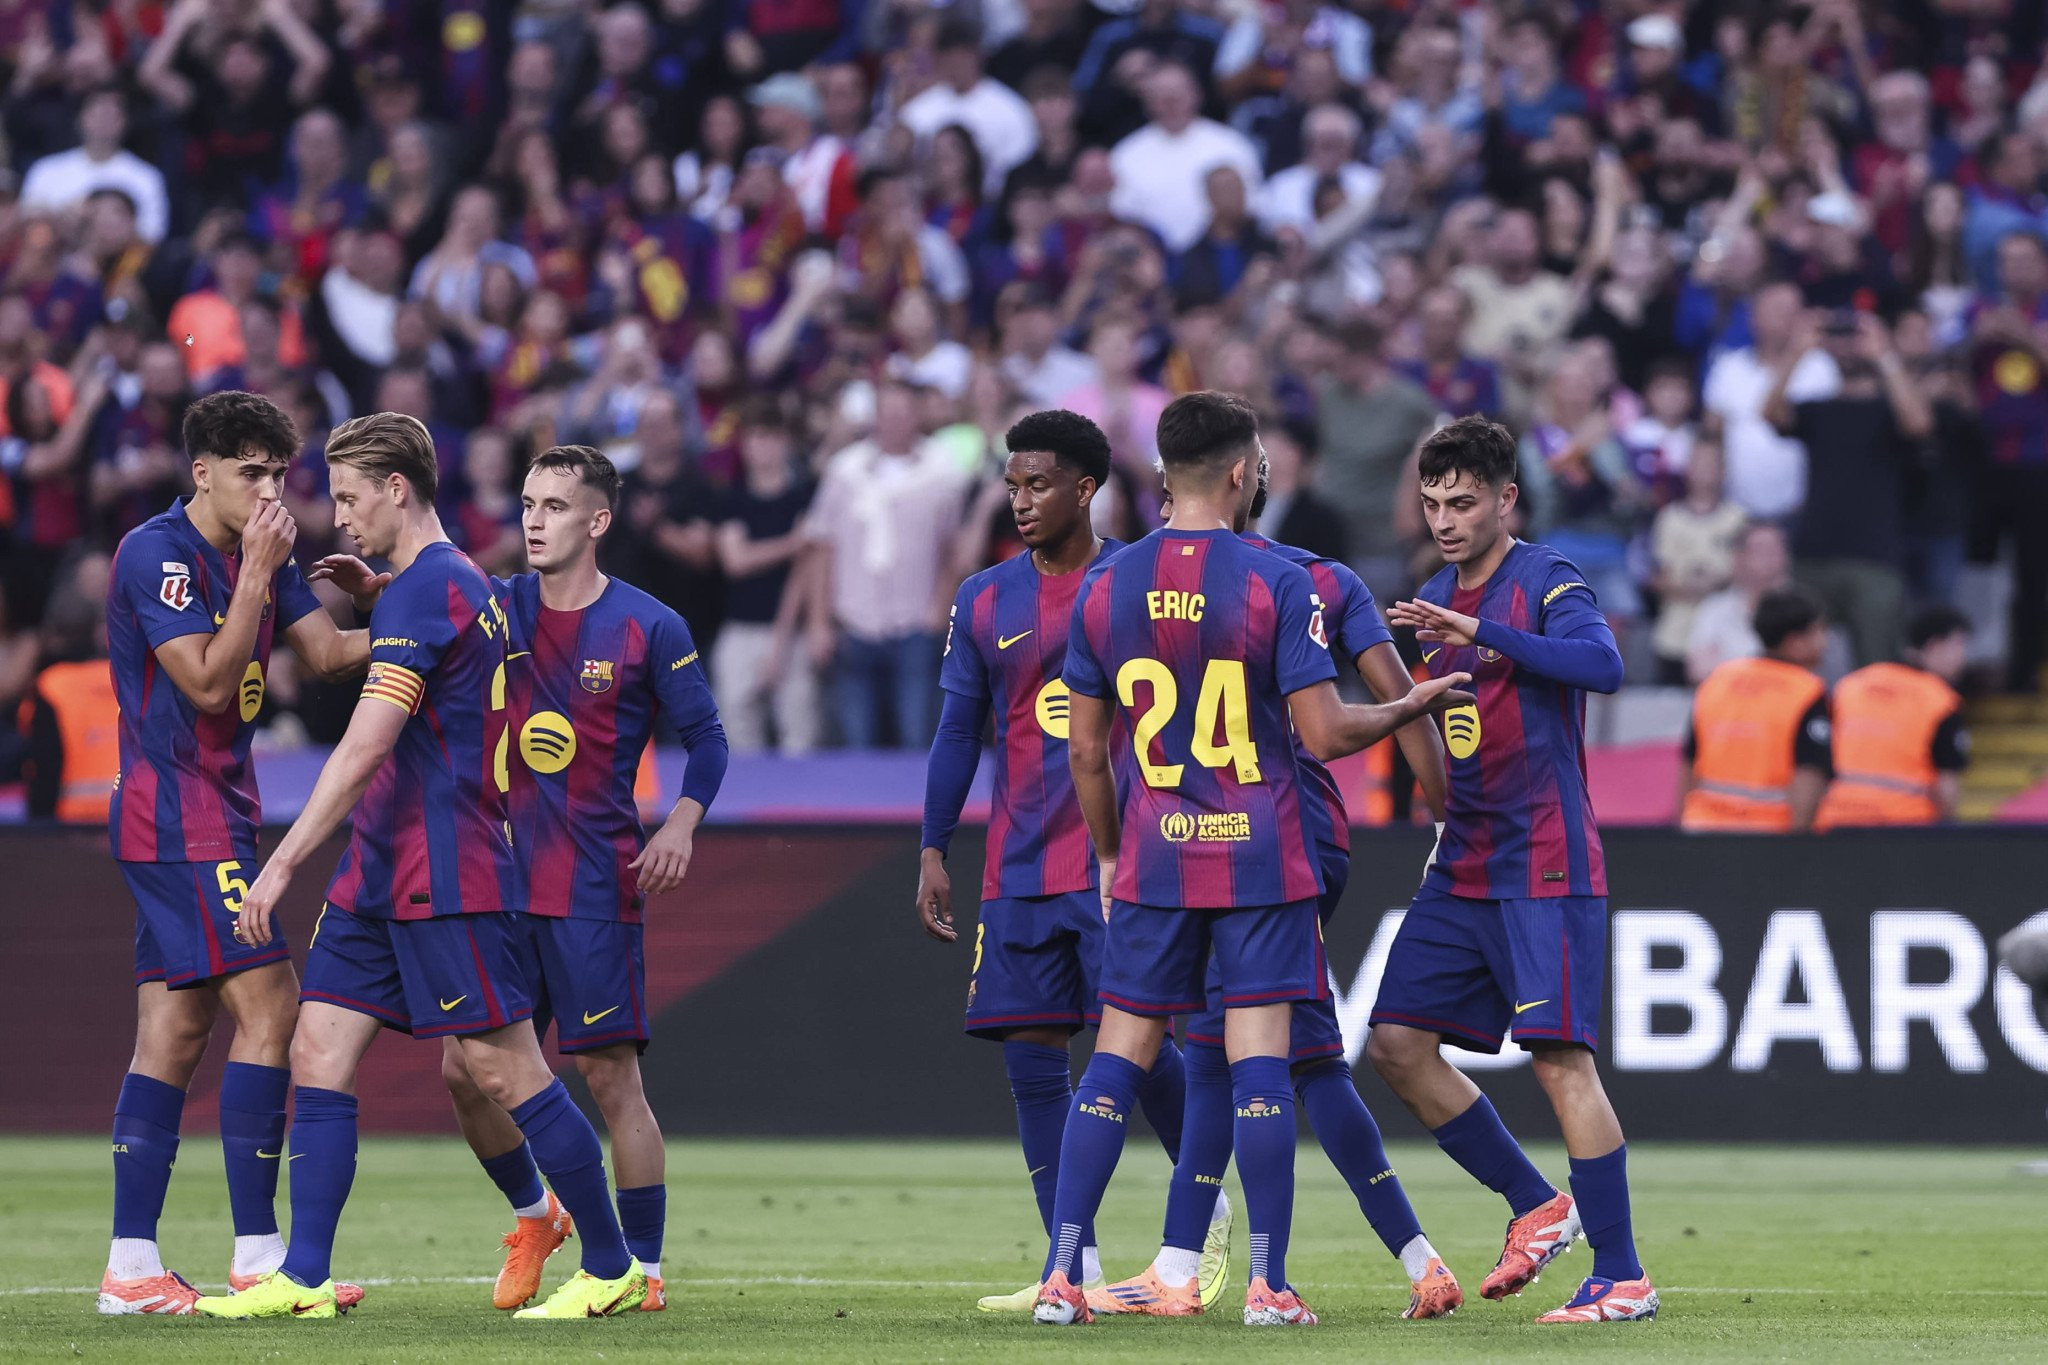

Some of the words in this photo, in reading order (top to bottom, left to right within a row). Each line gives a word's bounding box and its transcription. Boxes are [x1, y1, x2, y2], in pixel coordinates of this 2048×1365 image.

[1146, 590, 1206, 622] ERIC
[1116, 657, 1262, 787] 24
[1197, 812, 1249, 826] UNHCR
[1197, 824, 1251, 837] ACNUR
[215, 860, 249, 913] 5
